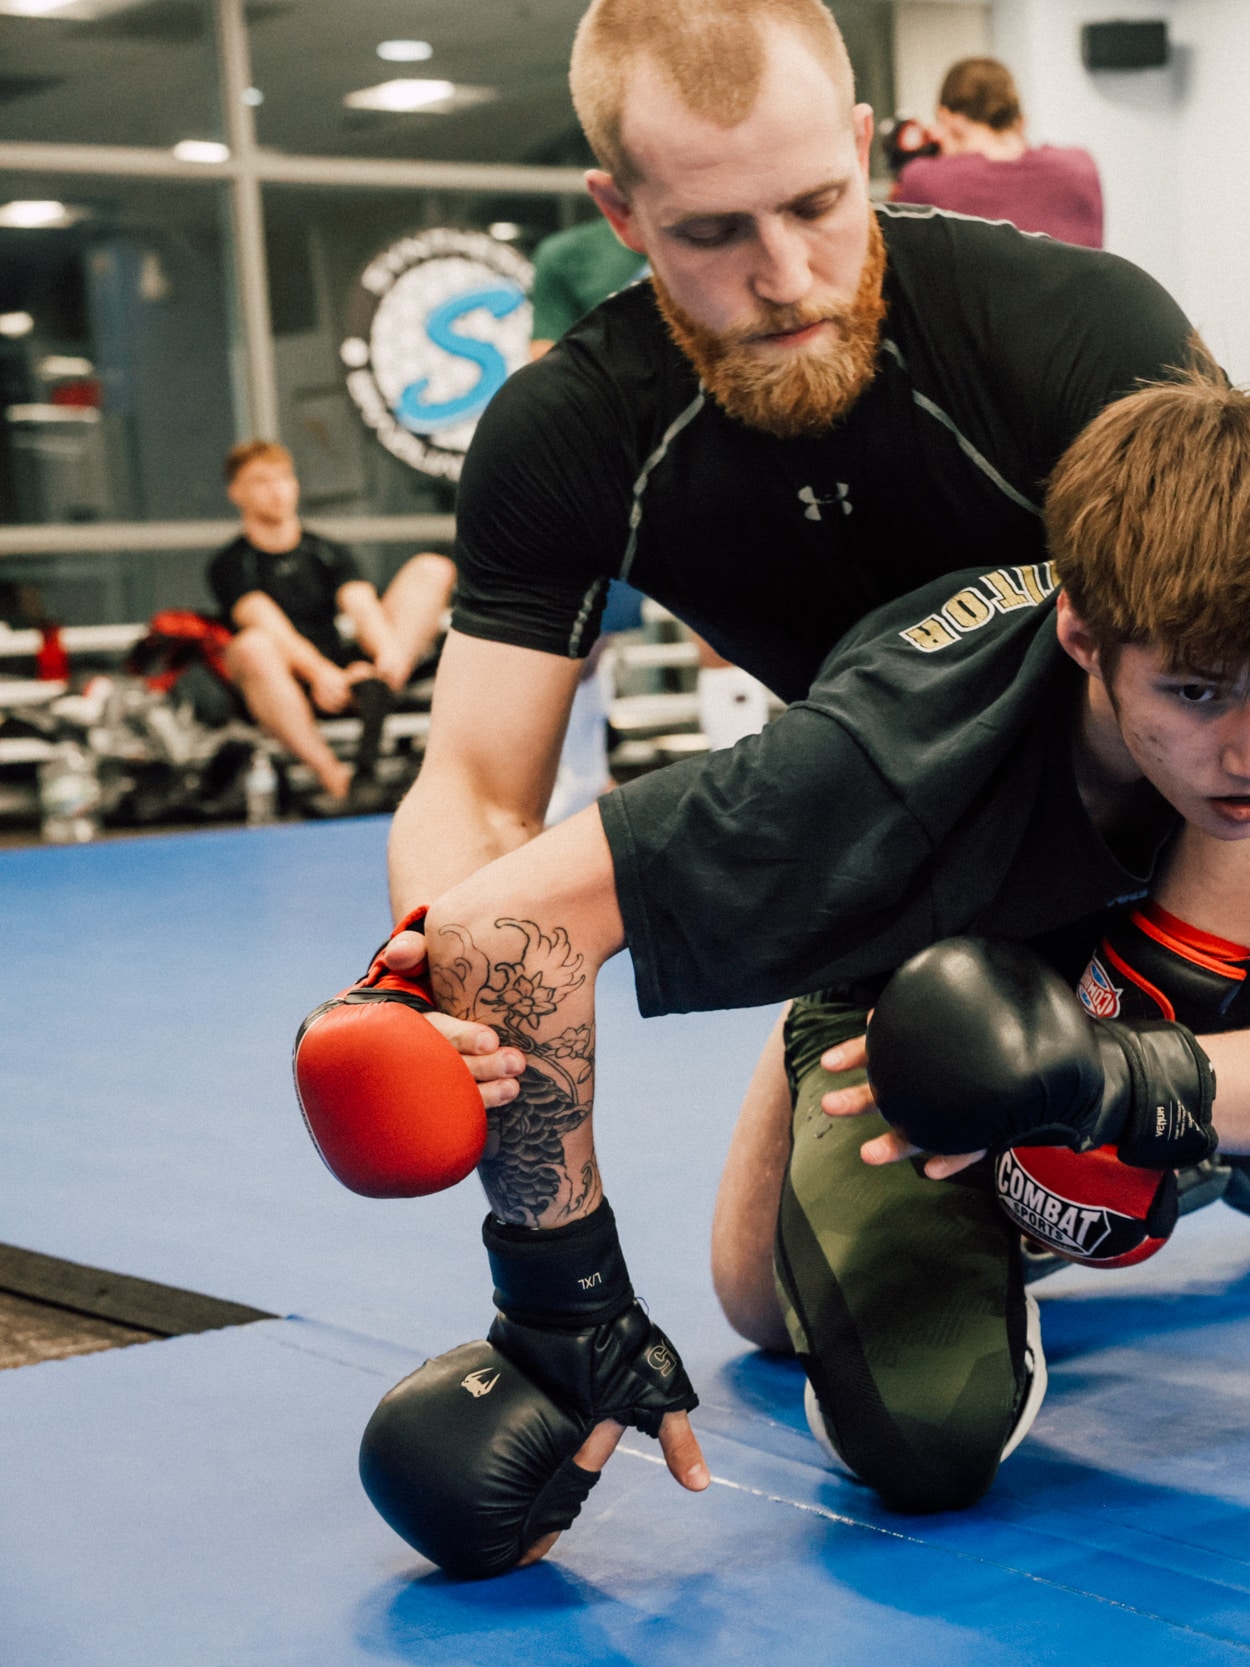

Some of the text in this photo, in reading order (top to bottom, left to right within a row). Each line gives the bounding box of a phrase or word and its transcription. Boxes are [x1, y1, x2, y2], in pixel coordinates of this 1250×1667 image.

[396, 287, 525, 424] S
[1155, 1106, 1167, 1137] VENUM
[999, 1150, 1102, 1246] COMBAT
[1013, 1203, 1064, 1241] SPORTS
[577, 1271, 602, 1290] L/XL
